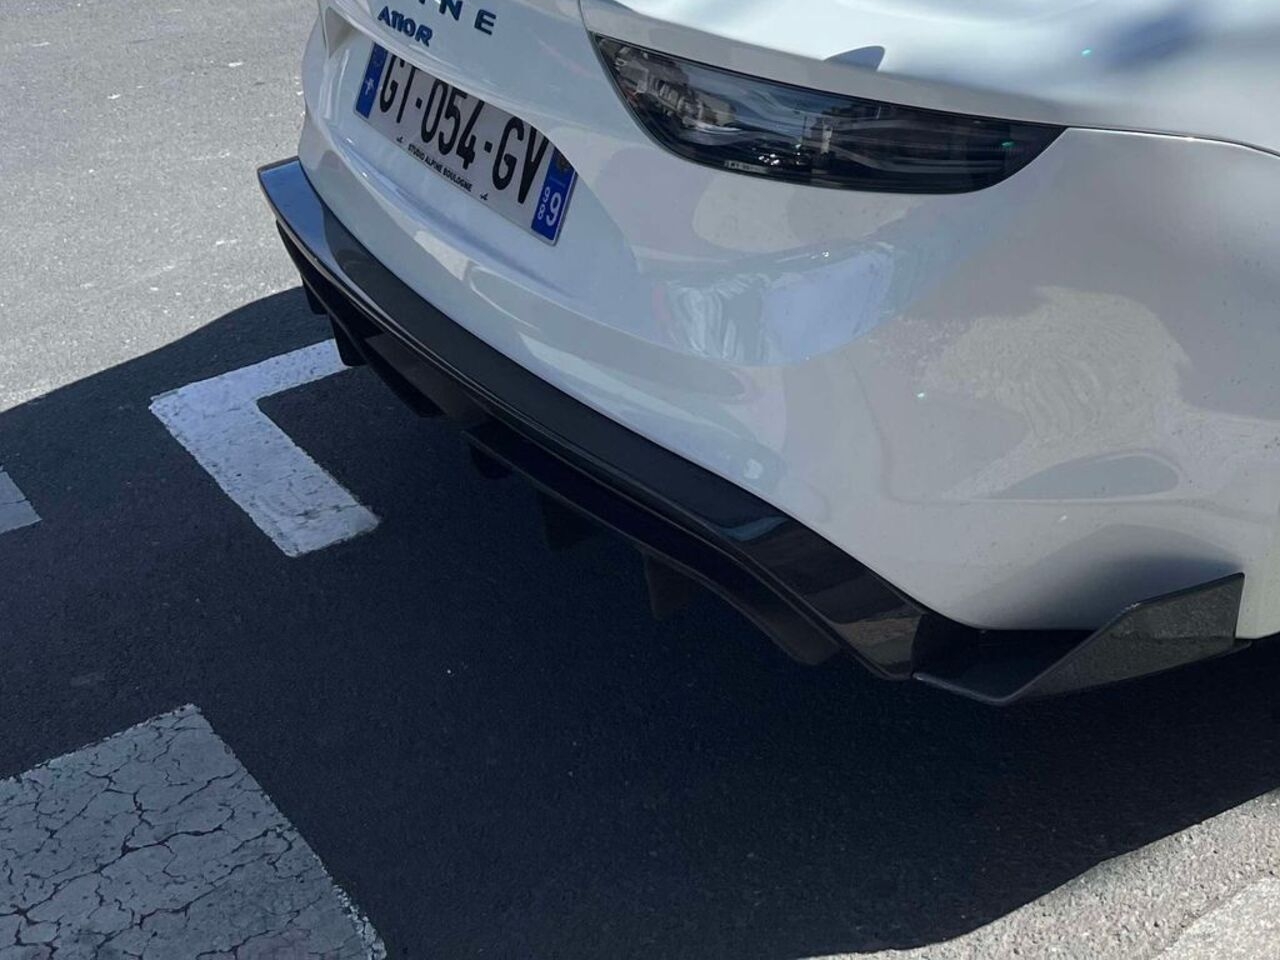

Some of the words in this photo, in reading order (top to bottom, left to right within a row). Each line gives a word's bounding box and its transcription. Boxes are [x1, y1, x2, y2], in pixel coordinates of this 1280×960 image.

[408, 143, 426, 161] STUDIO
[424, 155, 443, 173] ALPINE
[443, 167, 473, 192] BOULOGNE
